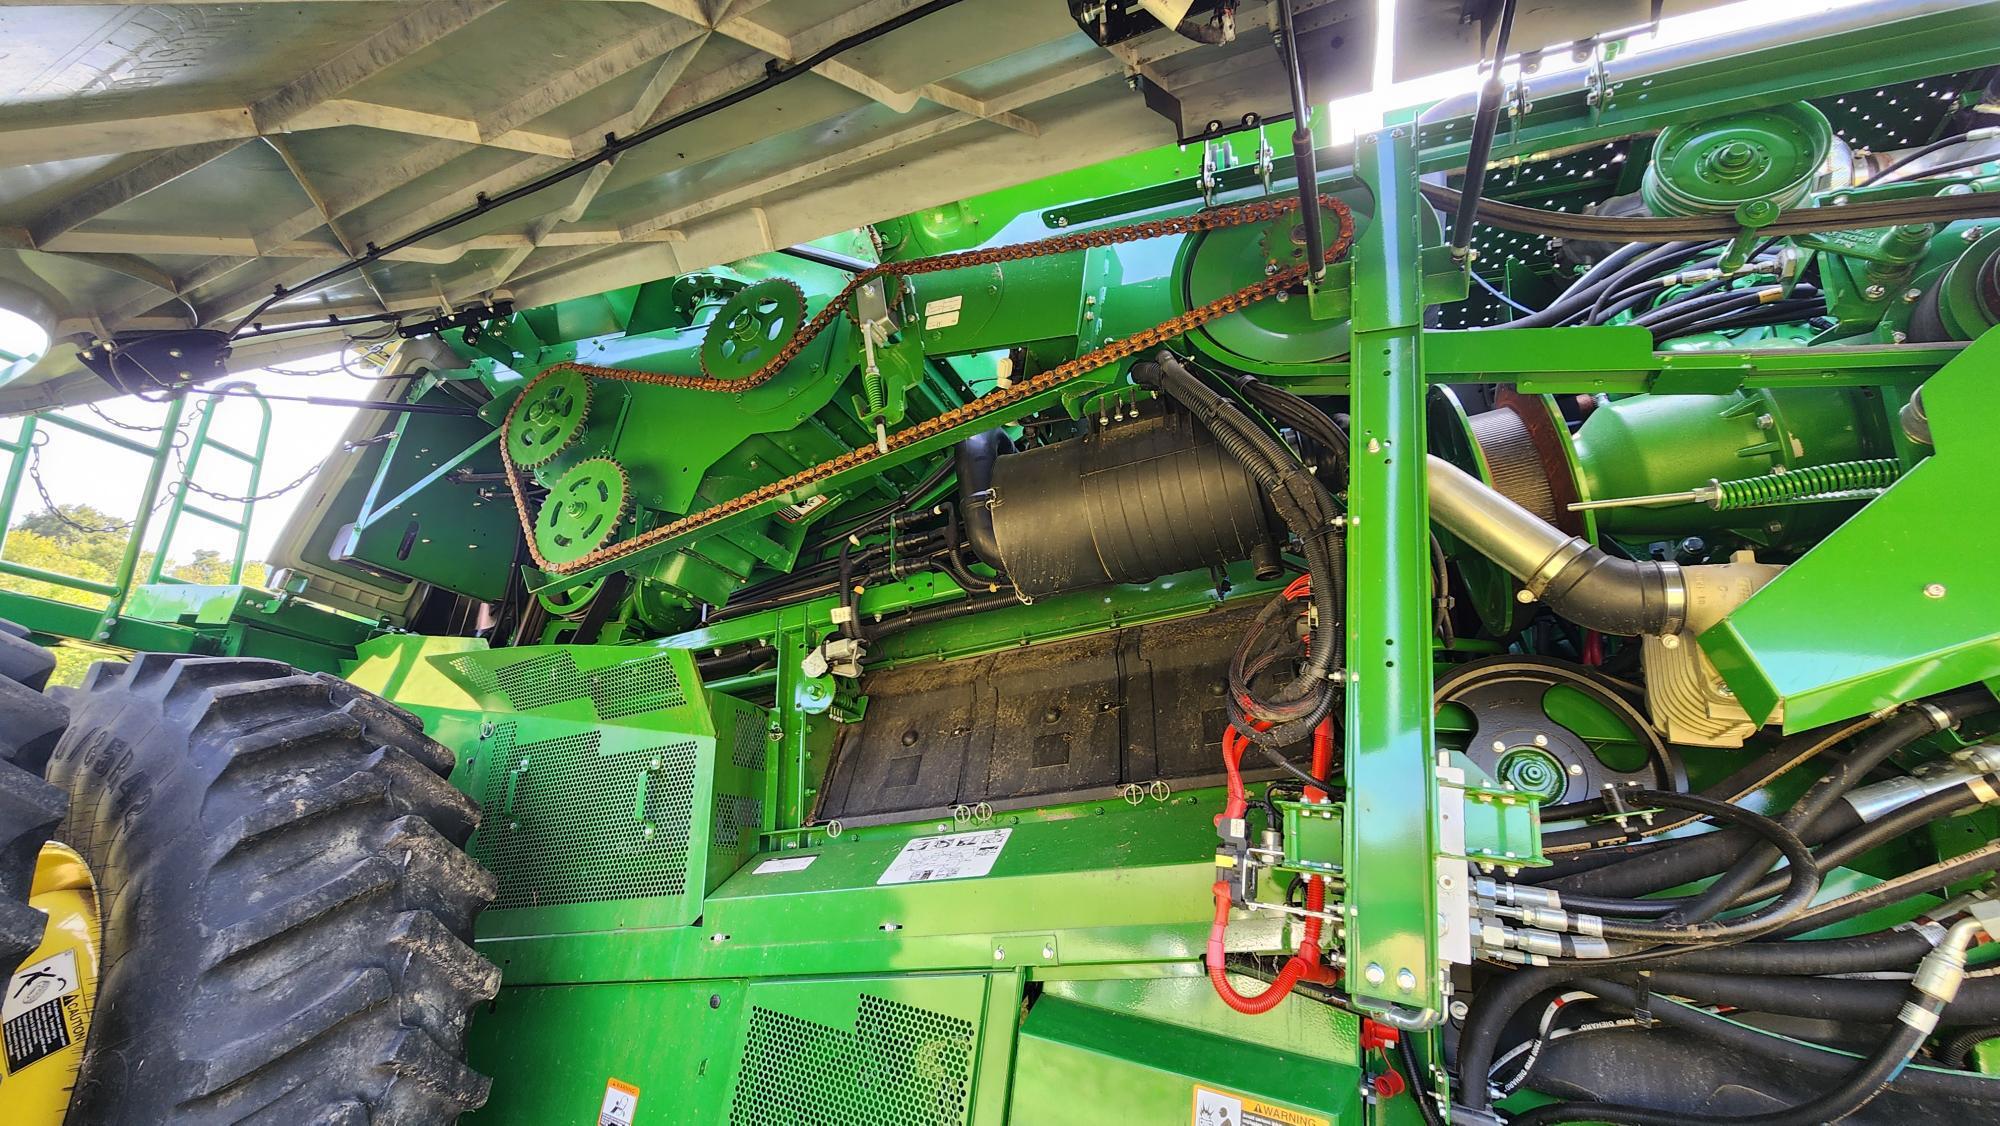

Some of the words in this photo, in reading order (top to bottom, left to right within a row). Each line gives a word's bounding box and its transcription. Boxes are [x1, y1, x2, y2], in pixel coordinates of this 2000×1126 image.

[66, 1002, 87, 1041] CAUTION
[1504, 1068, 1528, 1091] DIEHARD
[1263, 1104, 1316, 1126] WARNING
